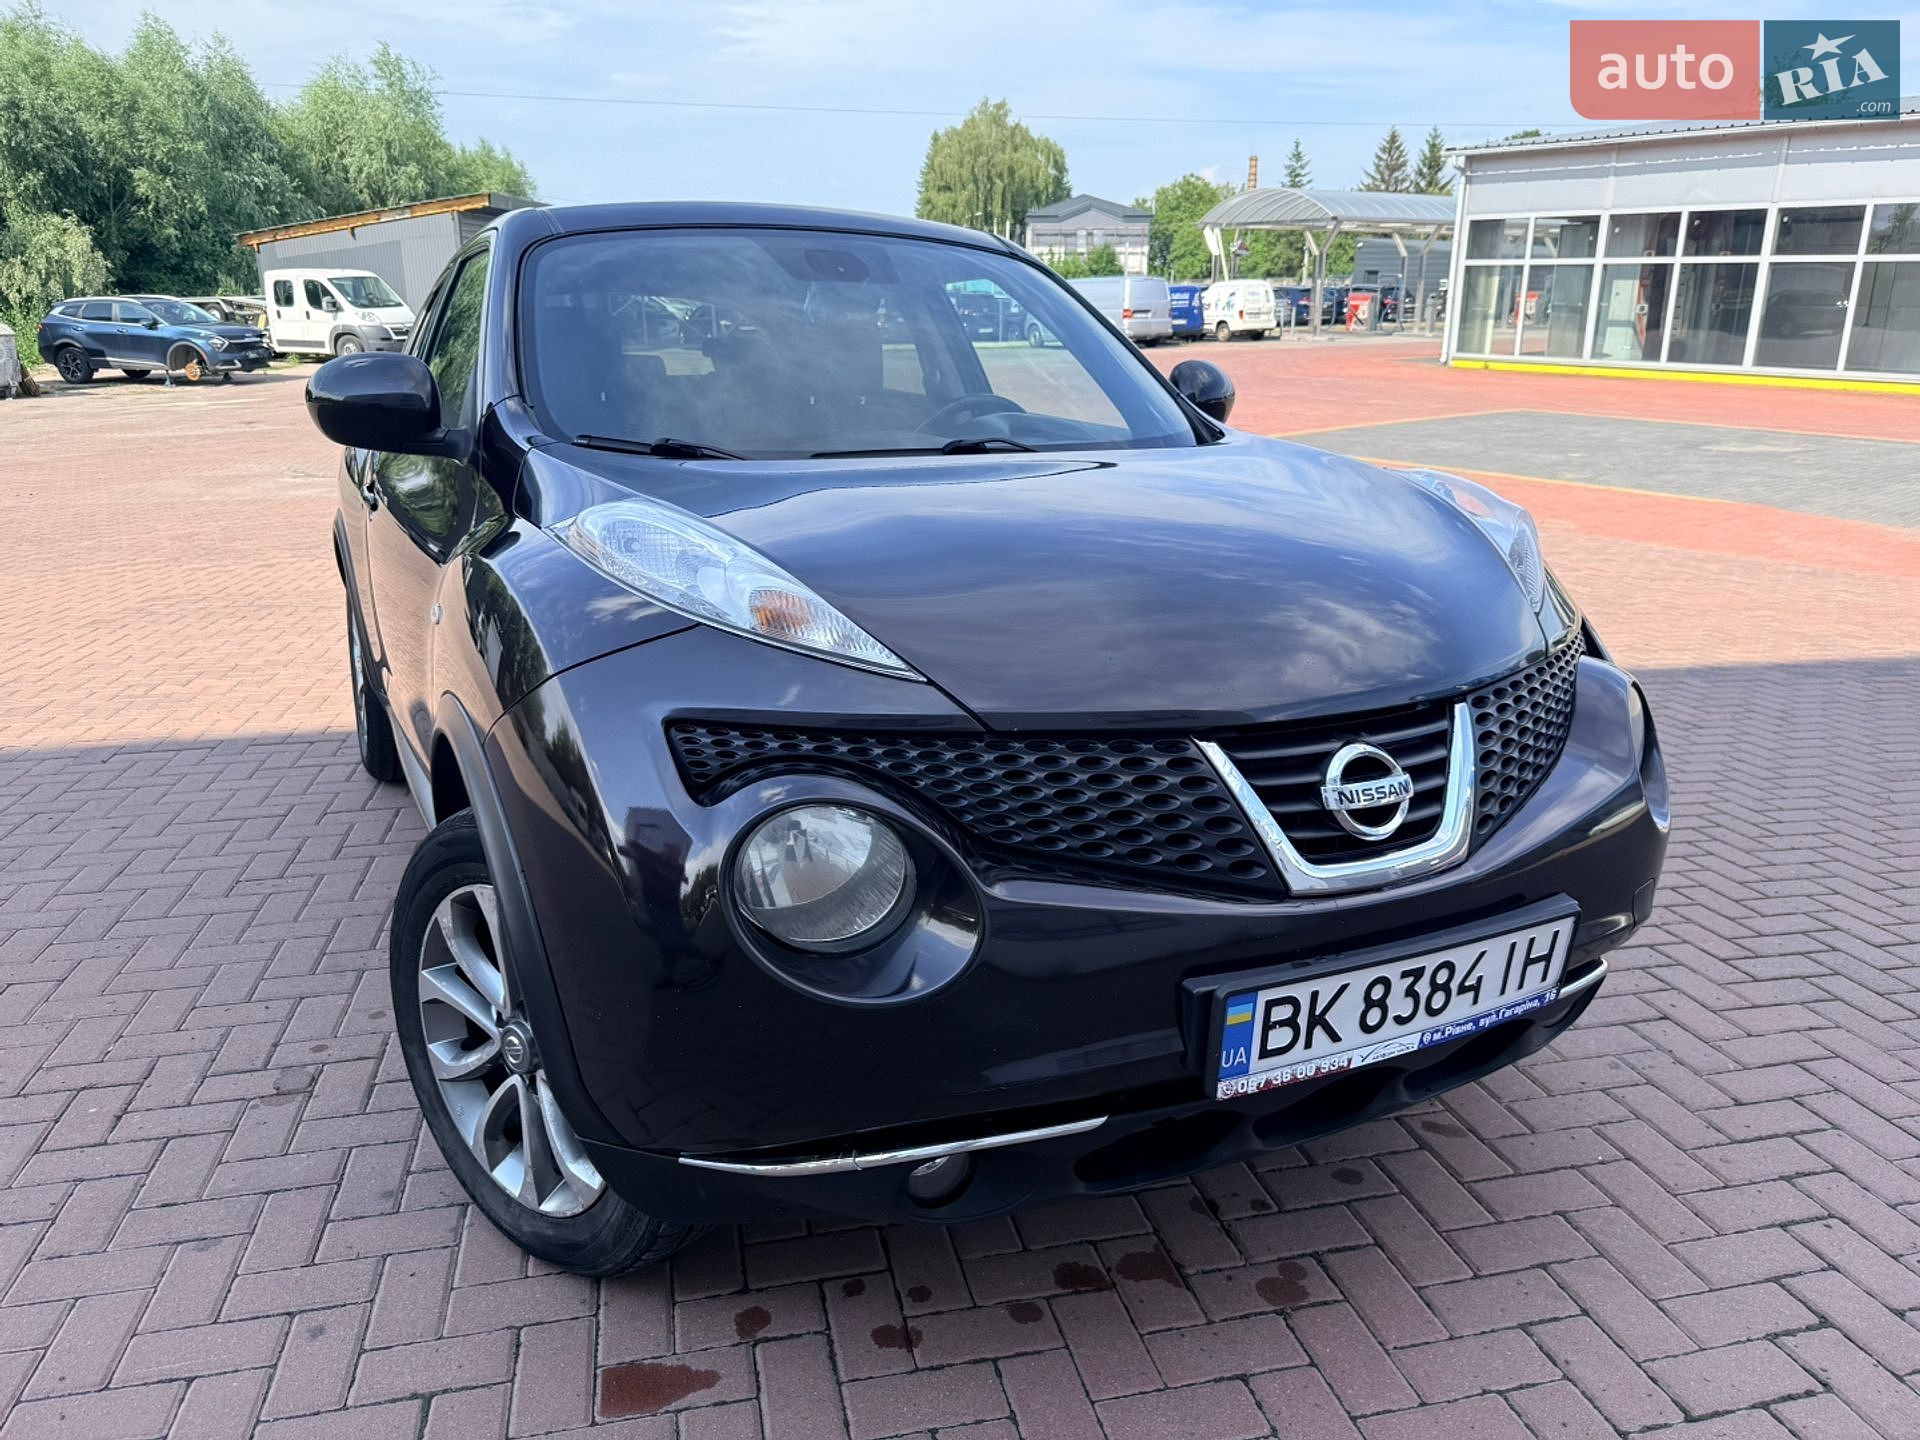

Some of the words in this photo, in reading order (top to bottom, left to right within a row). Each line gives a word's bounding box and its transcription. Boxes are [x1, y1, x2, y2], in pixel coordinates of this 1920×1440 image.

[1337, 780, 1410, 806] NISSAN
[1258, 982, 1350, 1060] BK
[1358, 950, 1489, 1036] 8384
[1499, 929, 1561, 997] IH
[1221, 1047, 1247, 1068] UA
